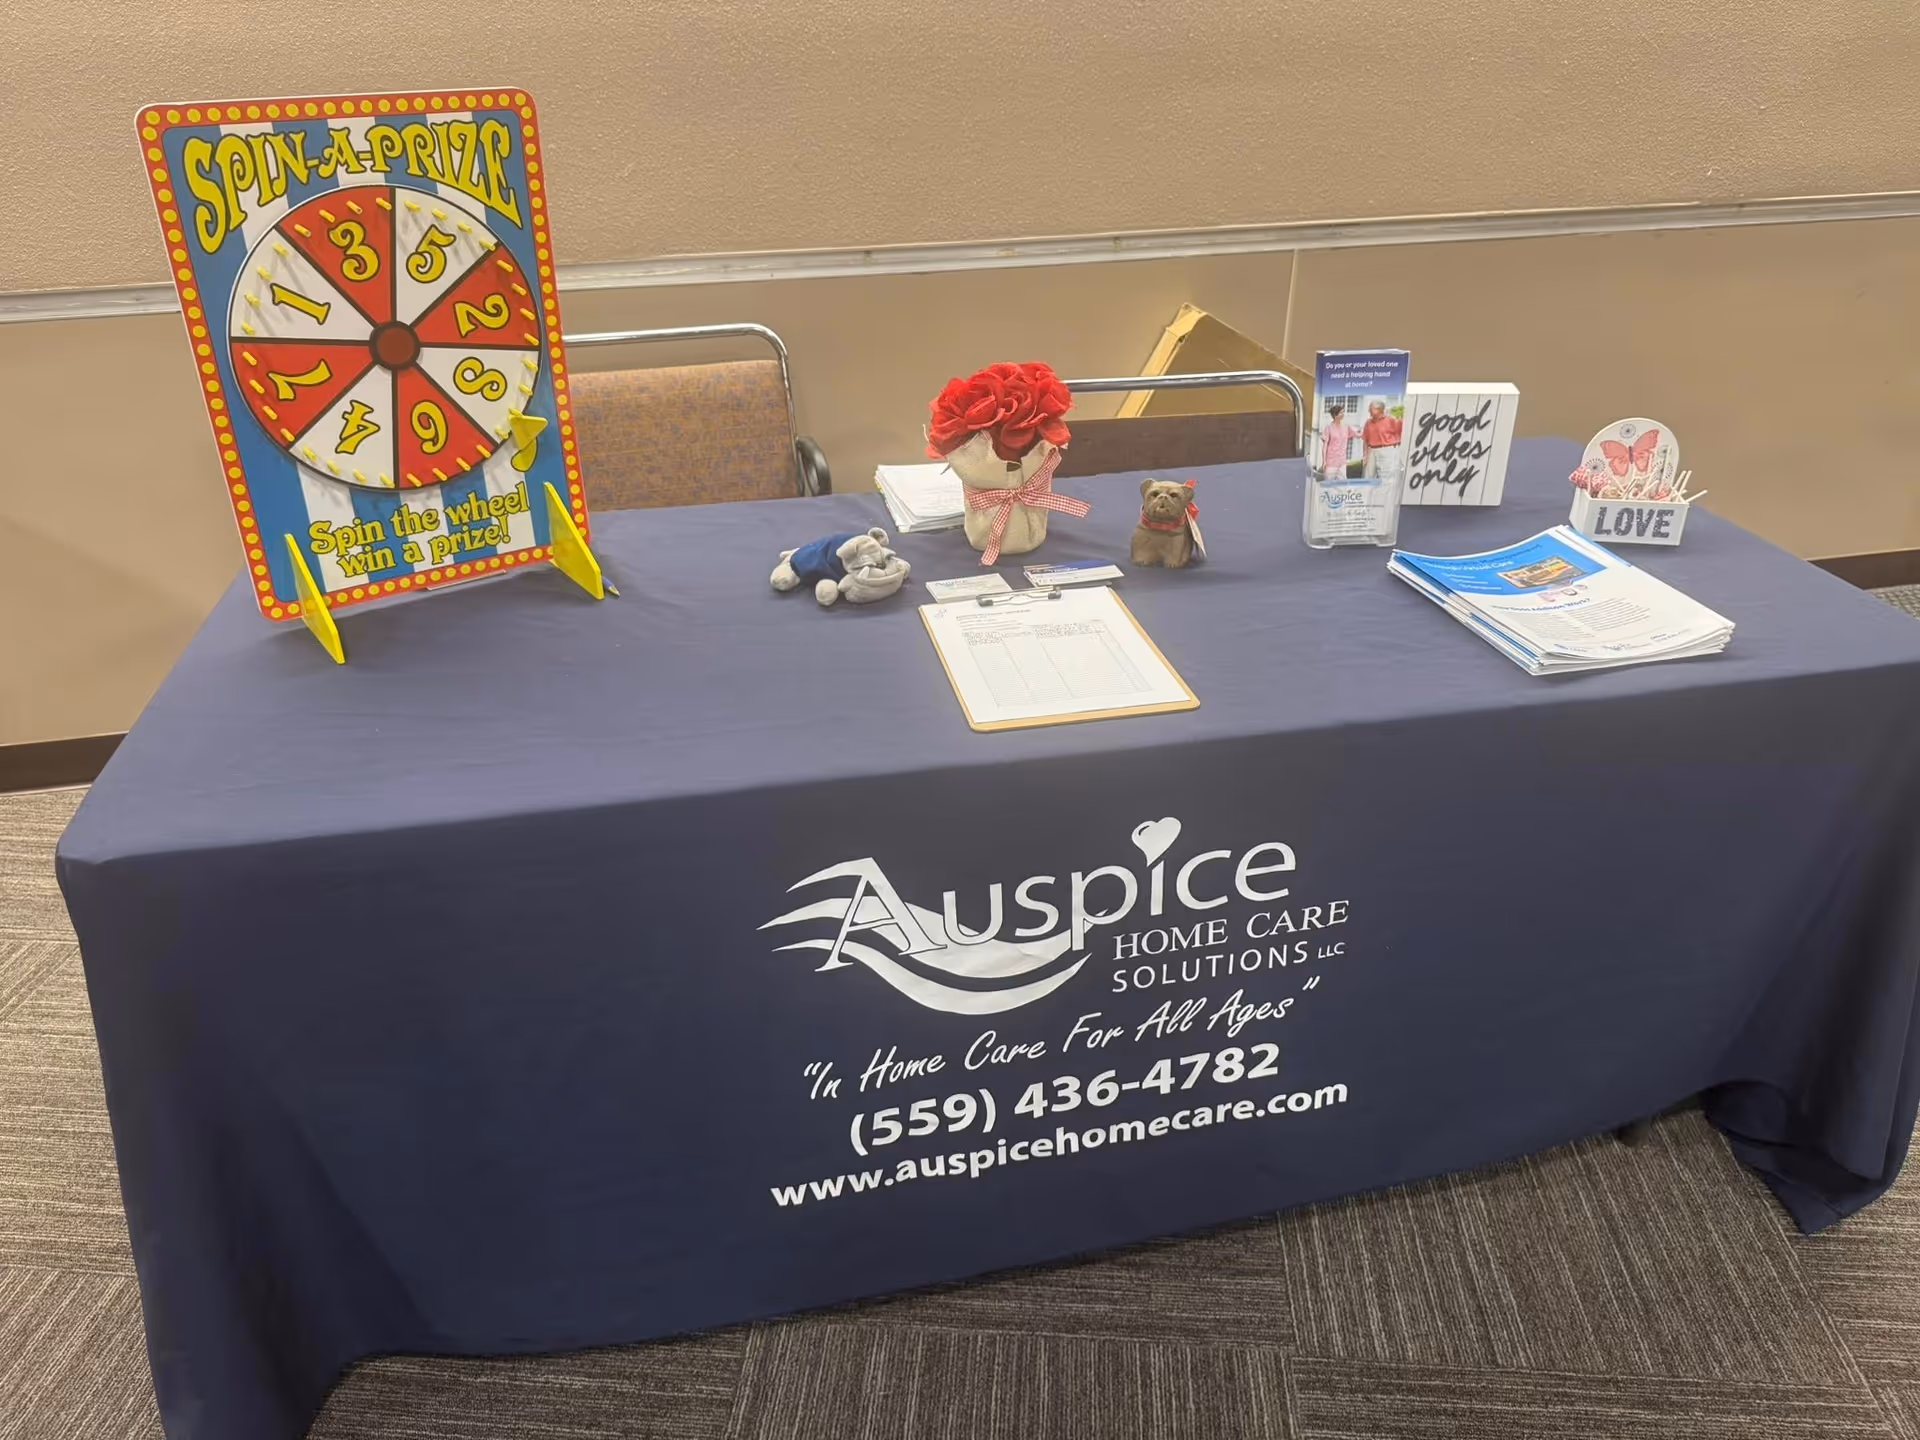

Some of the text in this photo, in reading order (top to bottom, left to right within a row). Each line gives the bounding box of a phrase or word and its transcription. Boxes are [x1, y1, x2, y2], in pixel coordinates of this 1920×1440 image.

[183, 119, 523, 254] SPIN-A-PRIZE
[328, 220, 380, 283] 3
[405, 225, 458, 283] 5
[271, 283, 331, 326] 1
[454, 294, 511, 337] 2
[267, 358, 333, 401] 7
[453, 356, 508, 401] 8
[1334, 362, 1344, 370] you
[1350, 371, 1373, 379] helping
[335, 399, 381, 455] 4
[1410, 432, 1492, 467] vibes
[1415, 399, 1492, 447] good
[1320, 489, 1362, 503] Auspice
[1409, 458, 1480, 498] only
[308, 481, 530, 556] Spin the wheel
[1594, 506, 1675, 538] LOVE
[336, 514, 511, 577] win a prize!
[815, 817, 1297, 973] Auspice
[1113, 900, 1350, 961] HOME CARE
[1112, 940, 1346, 993] SOLUTIONS LLC
[858, 1045, 946, 1095] Home
[963, 1030, 1046, 1071] Care
[1062, 1012, 1124, 1055] For
[1135, 997, 1206, 1043] All
[849, 1042, 1280, 1156] (559) 436-4782
[770, 1081, 1349, 1208] www.auspicehomecare.com
